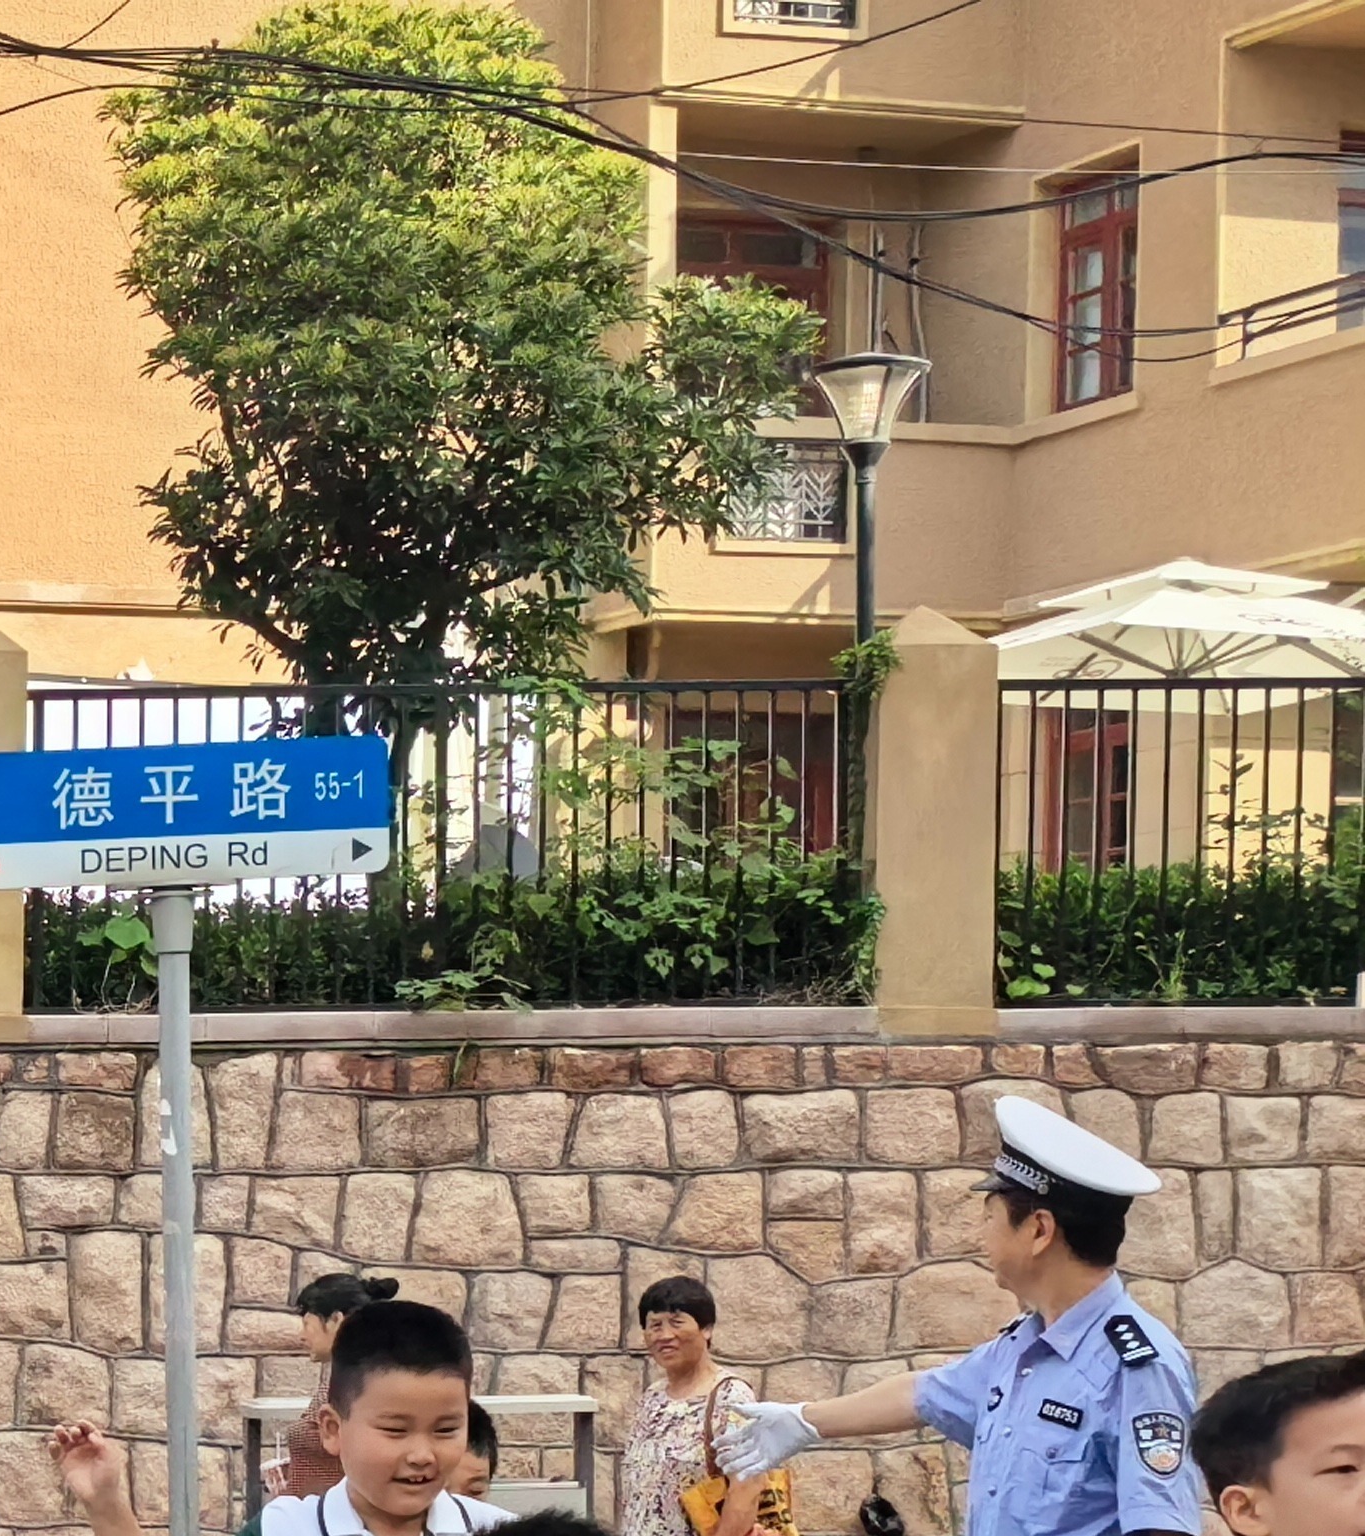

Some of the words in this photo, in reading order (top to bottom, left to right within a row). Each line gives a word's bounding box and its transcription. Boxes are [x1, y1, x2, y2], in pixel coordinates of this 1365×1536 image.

[52, 758, 291, 830] 德平路
[314, 769, 365, 801] 55-1
[80, 843, 208, 874] DEPING
[227, 841, 269, 868] Rd
